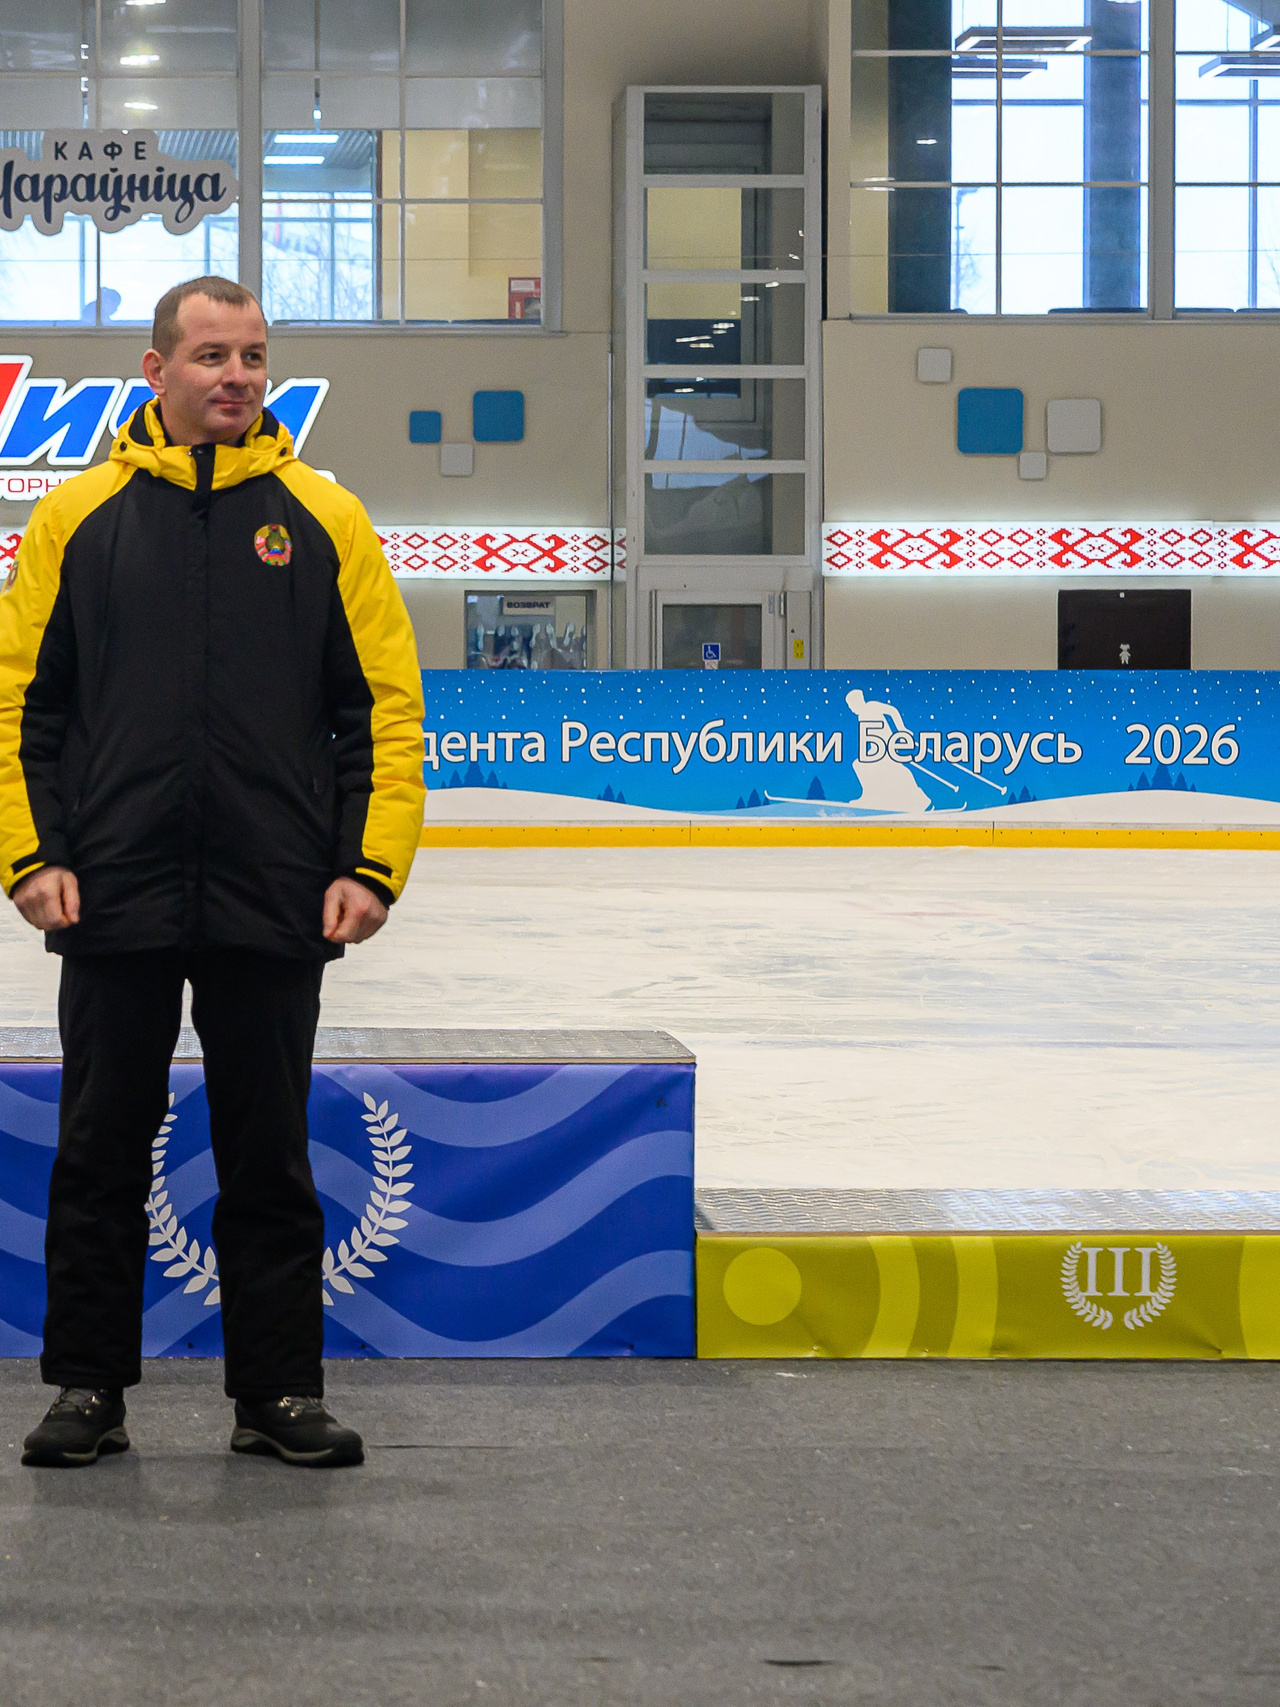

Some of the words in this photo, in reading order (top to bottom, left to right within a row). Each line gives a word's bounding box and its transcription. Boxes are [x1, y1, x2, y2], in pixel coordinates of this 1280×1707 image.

[54, 141, 147, 161] КАФЕ
[560, 719, 843, 775] Республики
[858, 720, 1084, 775] Беларусь
[1124, 723, 1240, 766] 2026
[1081, 1247, 1158, 1296] III
